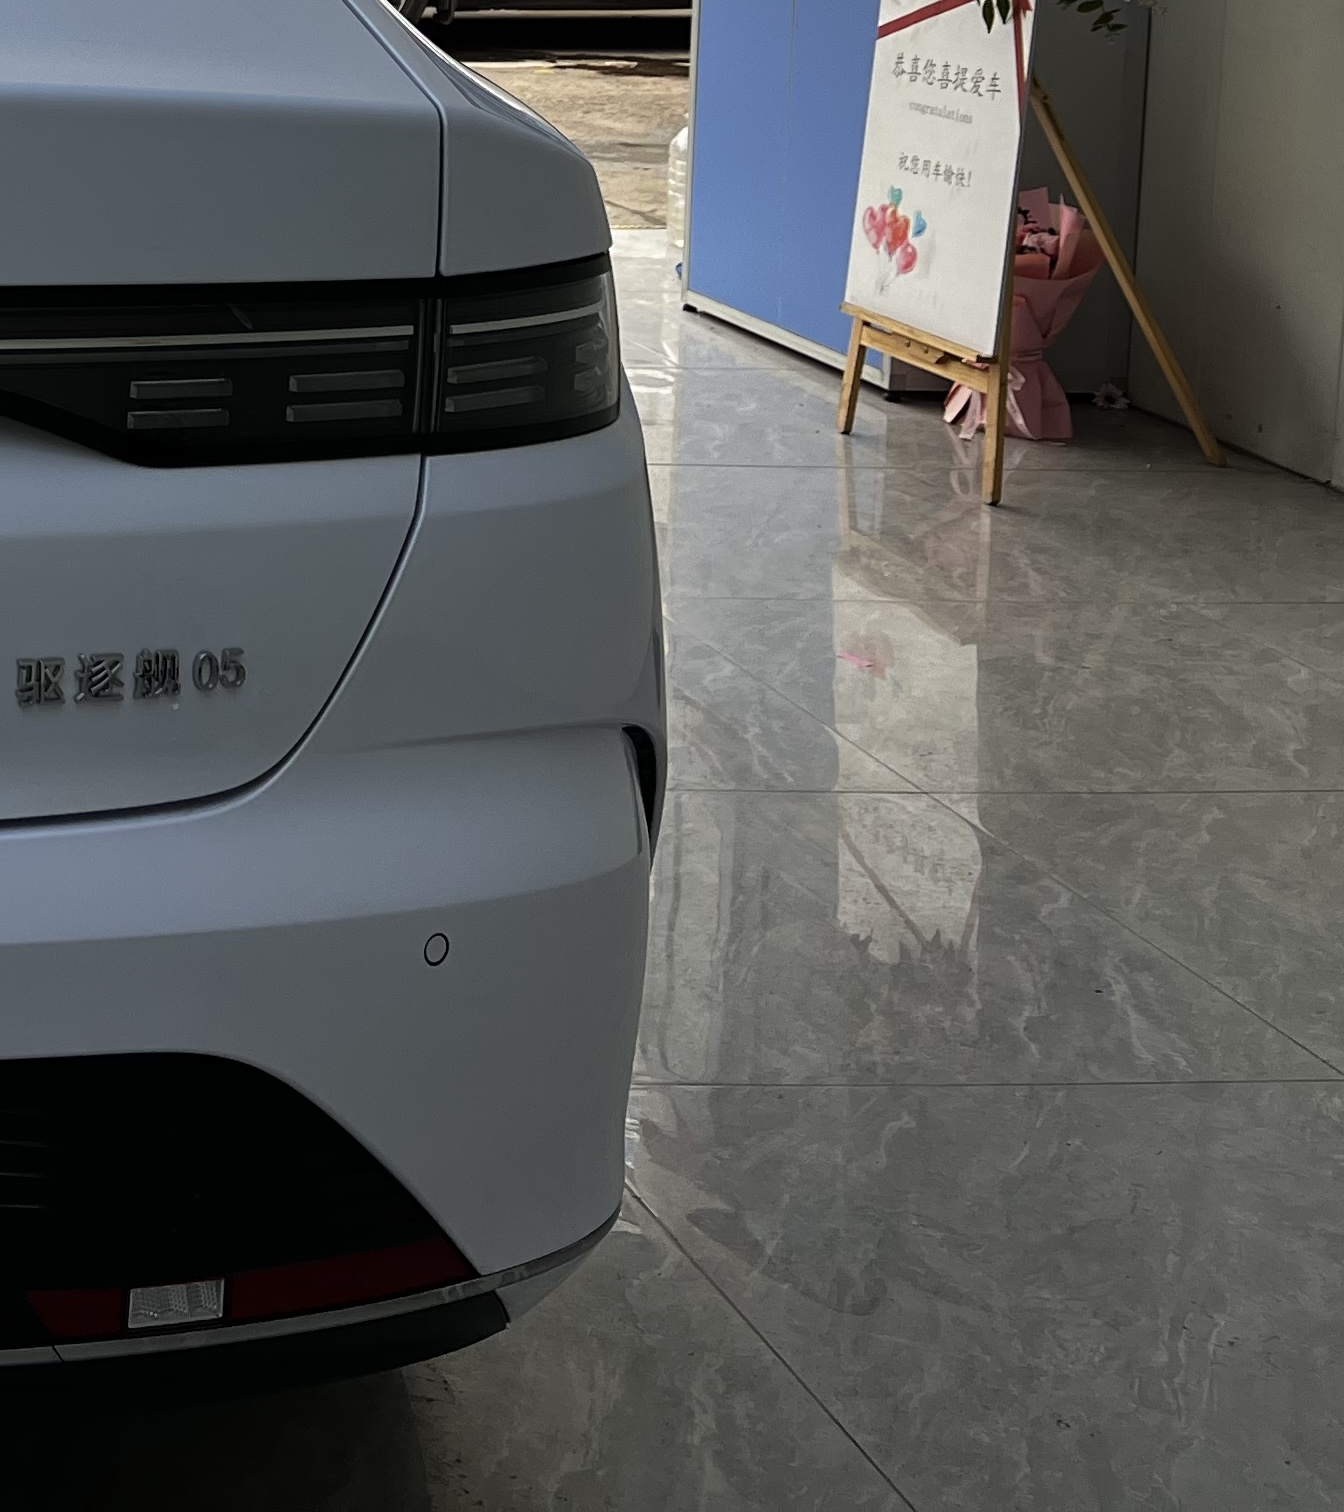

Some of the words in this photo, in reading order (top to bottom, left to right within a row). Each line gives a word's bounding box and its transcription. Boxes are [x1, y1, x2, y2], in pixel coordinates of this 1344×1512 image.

[892, 52, 1002, 100] 恭喜您喜提爱车
